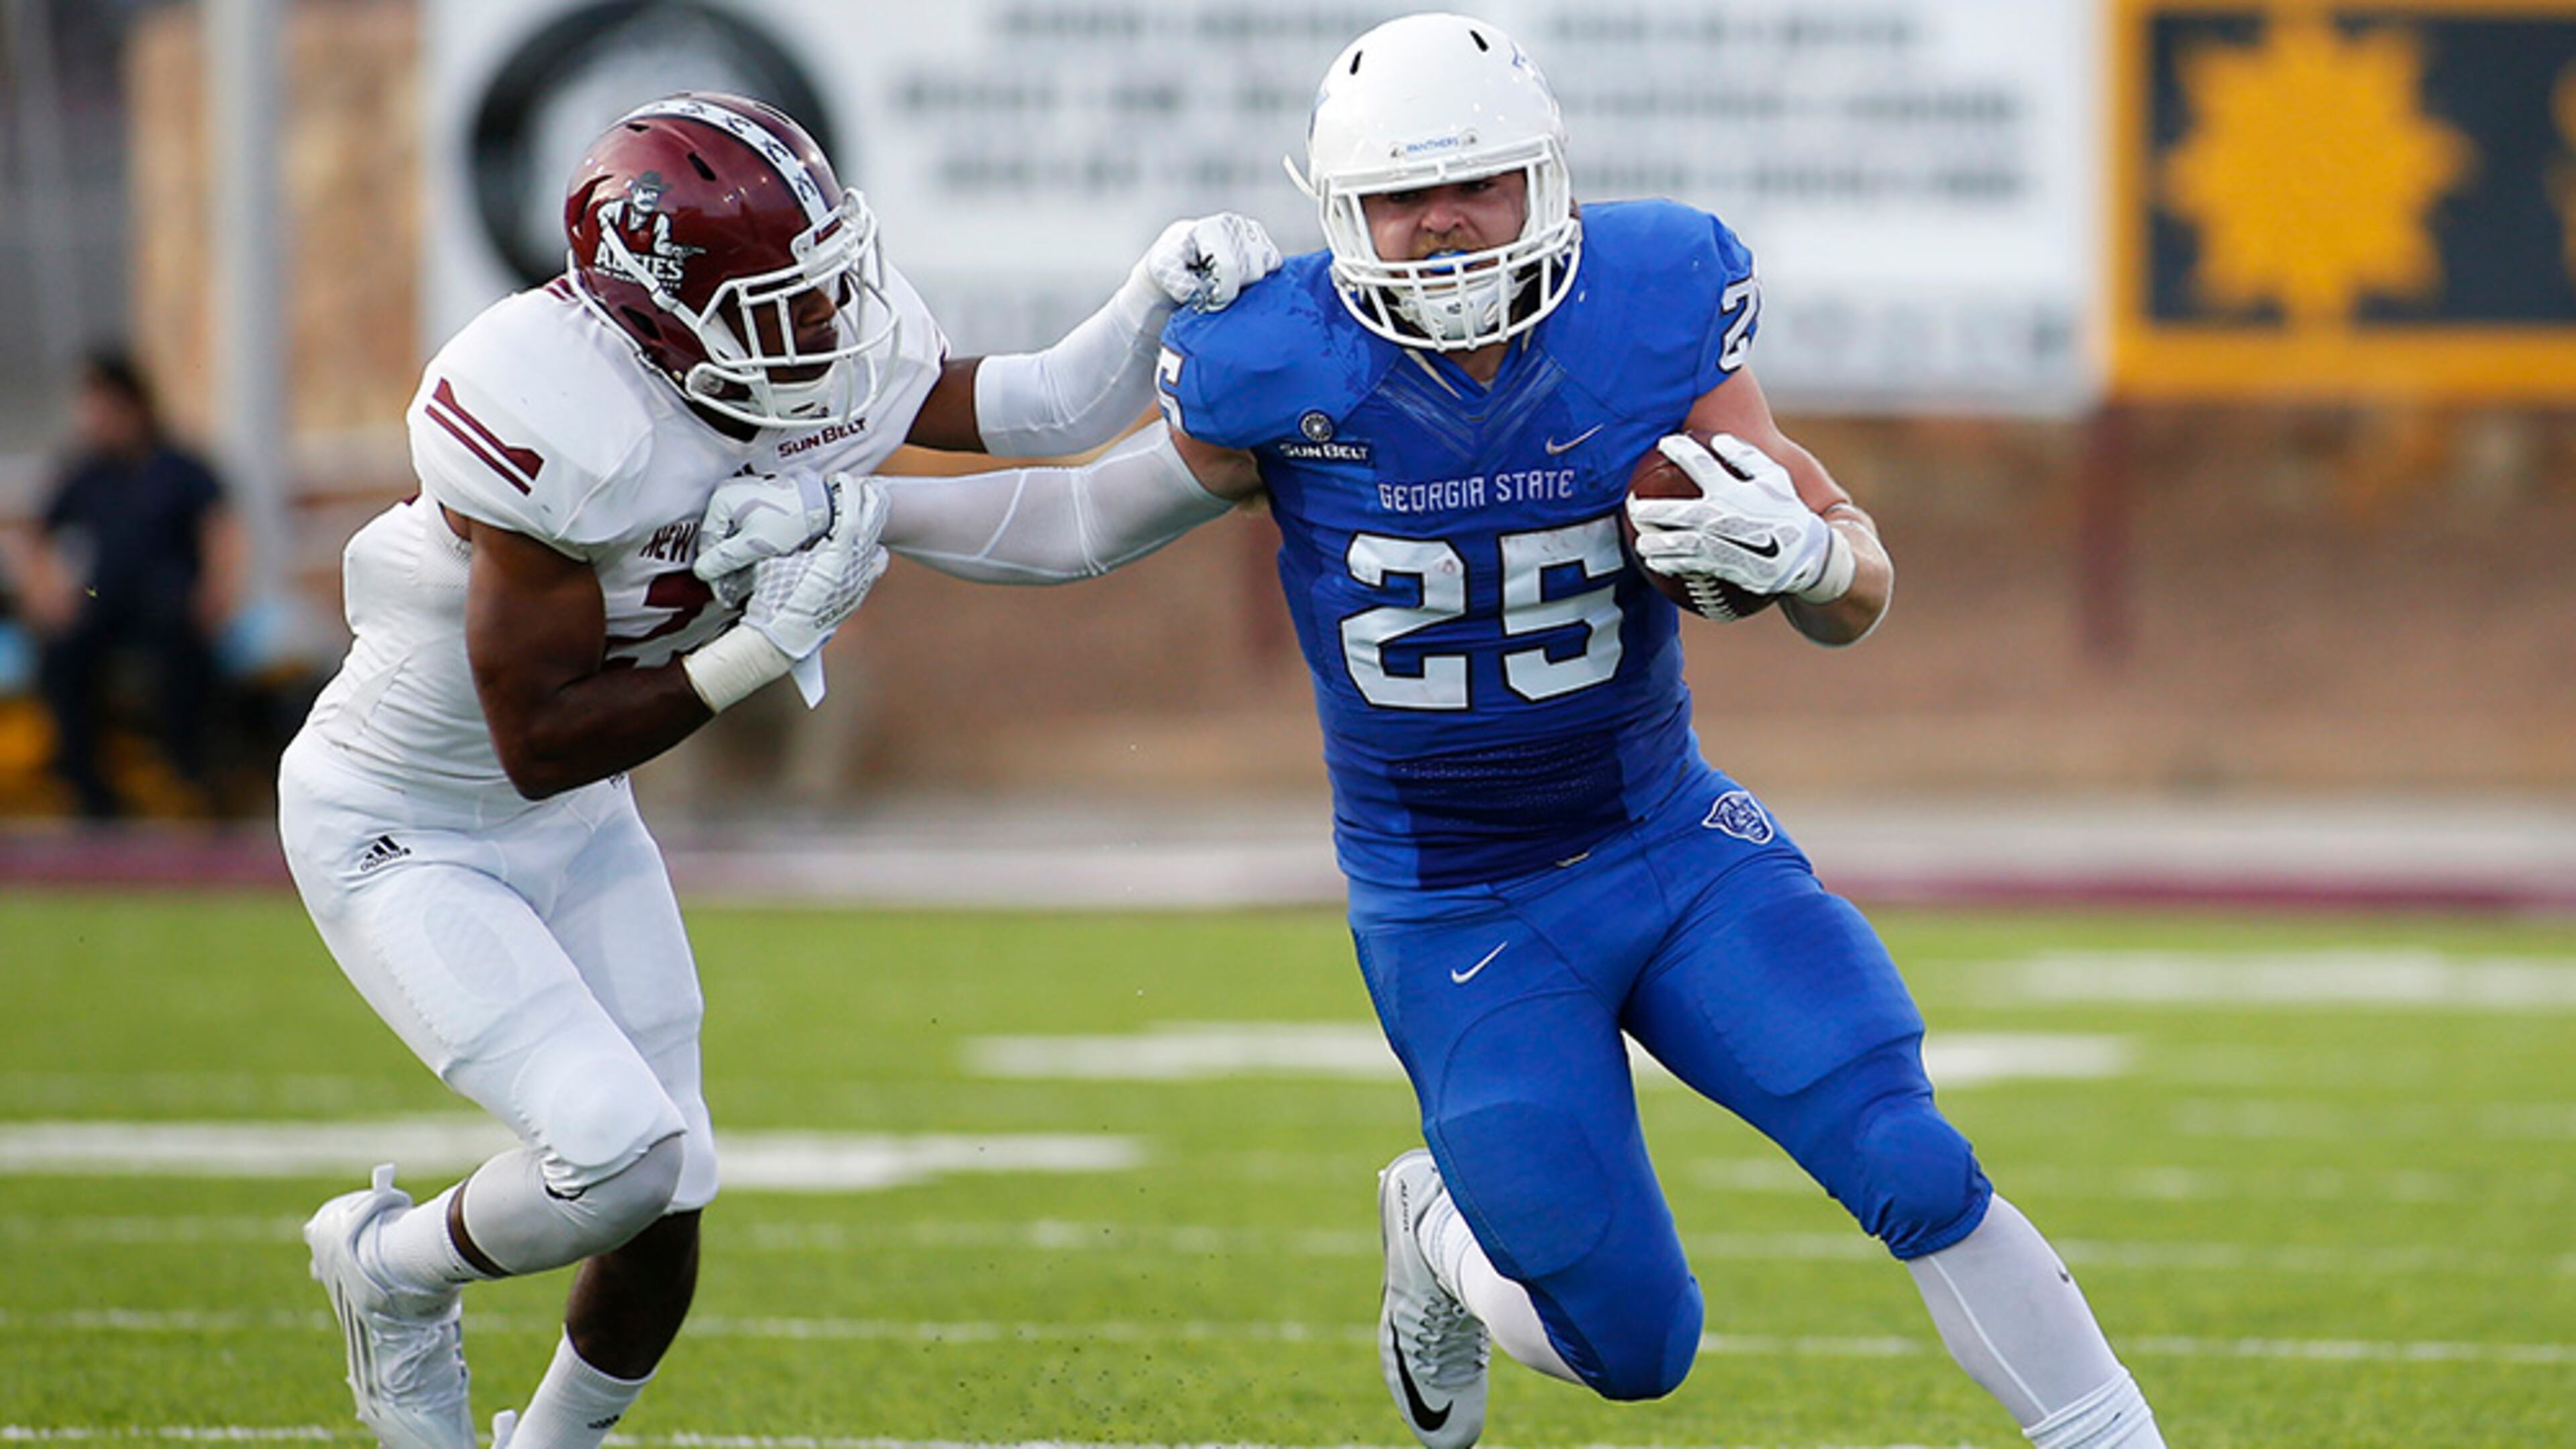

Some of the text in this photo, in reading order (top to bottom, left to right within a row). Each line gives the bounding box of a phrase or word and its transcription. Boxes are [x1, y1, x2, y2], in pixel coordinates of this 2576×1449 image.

[594, 241, 684, 281] AIES
[1377, 468, 1575, 513] GEORGIA STATE
[1339, 513, 1625, 710] 25
